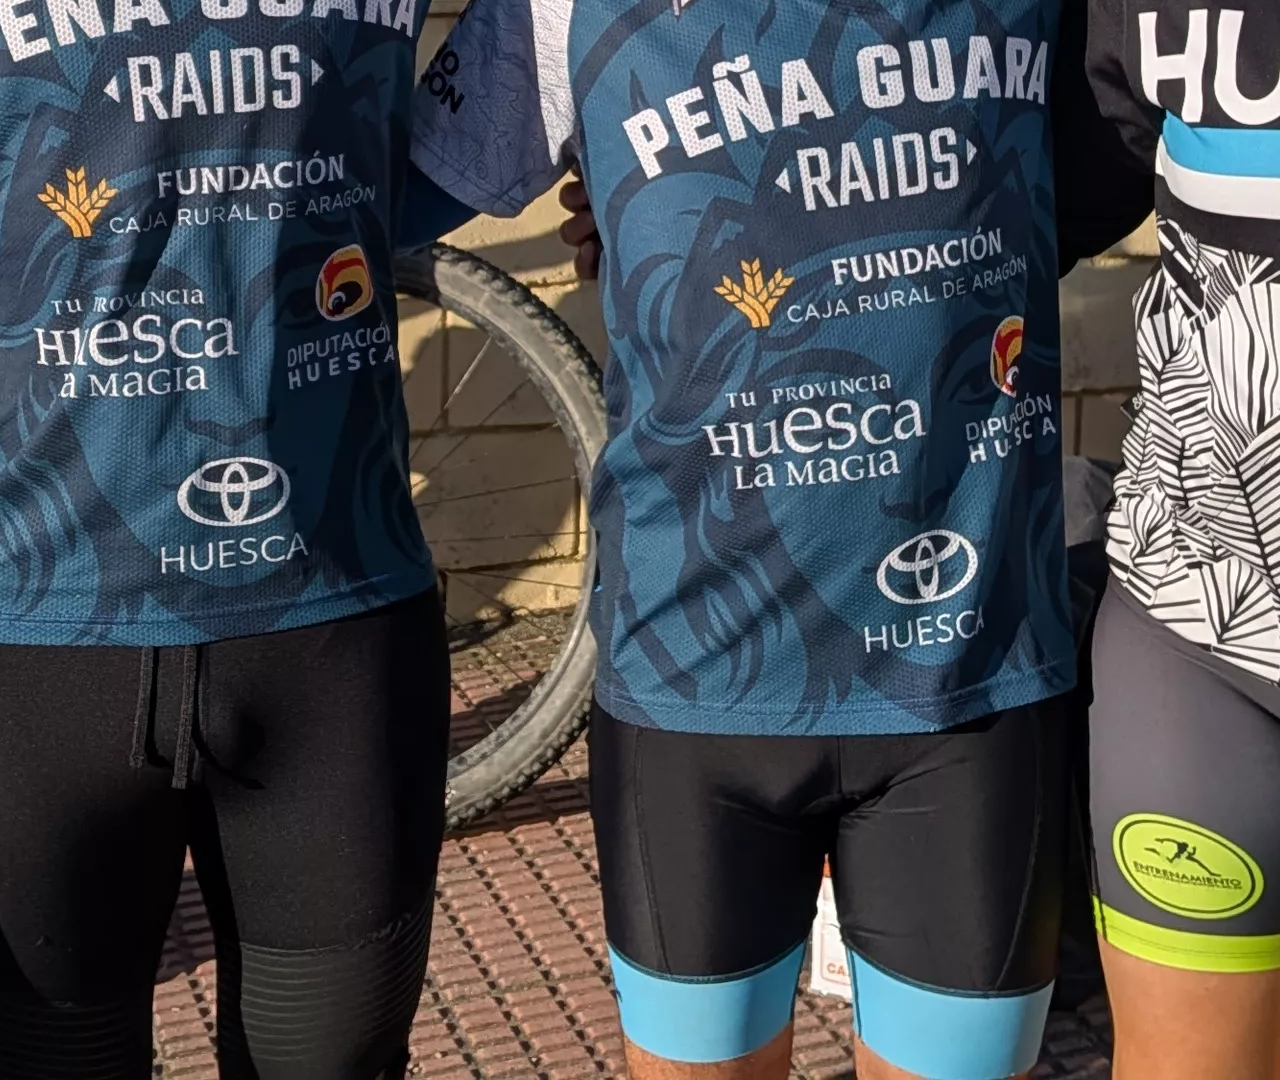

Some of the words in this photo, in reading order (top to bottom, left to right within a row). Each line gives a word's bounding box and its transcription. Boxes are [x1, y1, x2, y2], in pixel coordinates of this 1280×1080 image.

[127, 44, 302, 122] RAIDS
[622, 54, 835, 180] PEÑA
[856, 34, 1048, 109] GUARA
[157, 150, 346, 199] FUNDACIÓN
[796, 126, 960, 212] RAIDS
[109, 209, 169, 236] CAJA
[176, 200, 259, 228] RURAL
[268, 198, 298, 220] DE
[304, 183, 376, 218] ARAGÓN
[831, 226, 1003, 285] FUNDACIÓN
[786, 297, 851, 324] CAJA
[858, 288, 936, 314] RURAL
[942, 277, 967, 300] DE
[971, 254, 1028, 295] ARAGÓN
[288, 344, 395, 390] HUESCA
[160, 530, 308, 575] HUESCA
